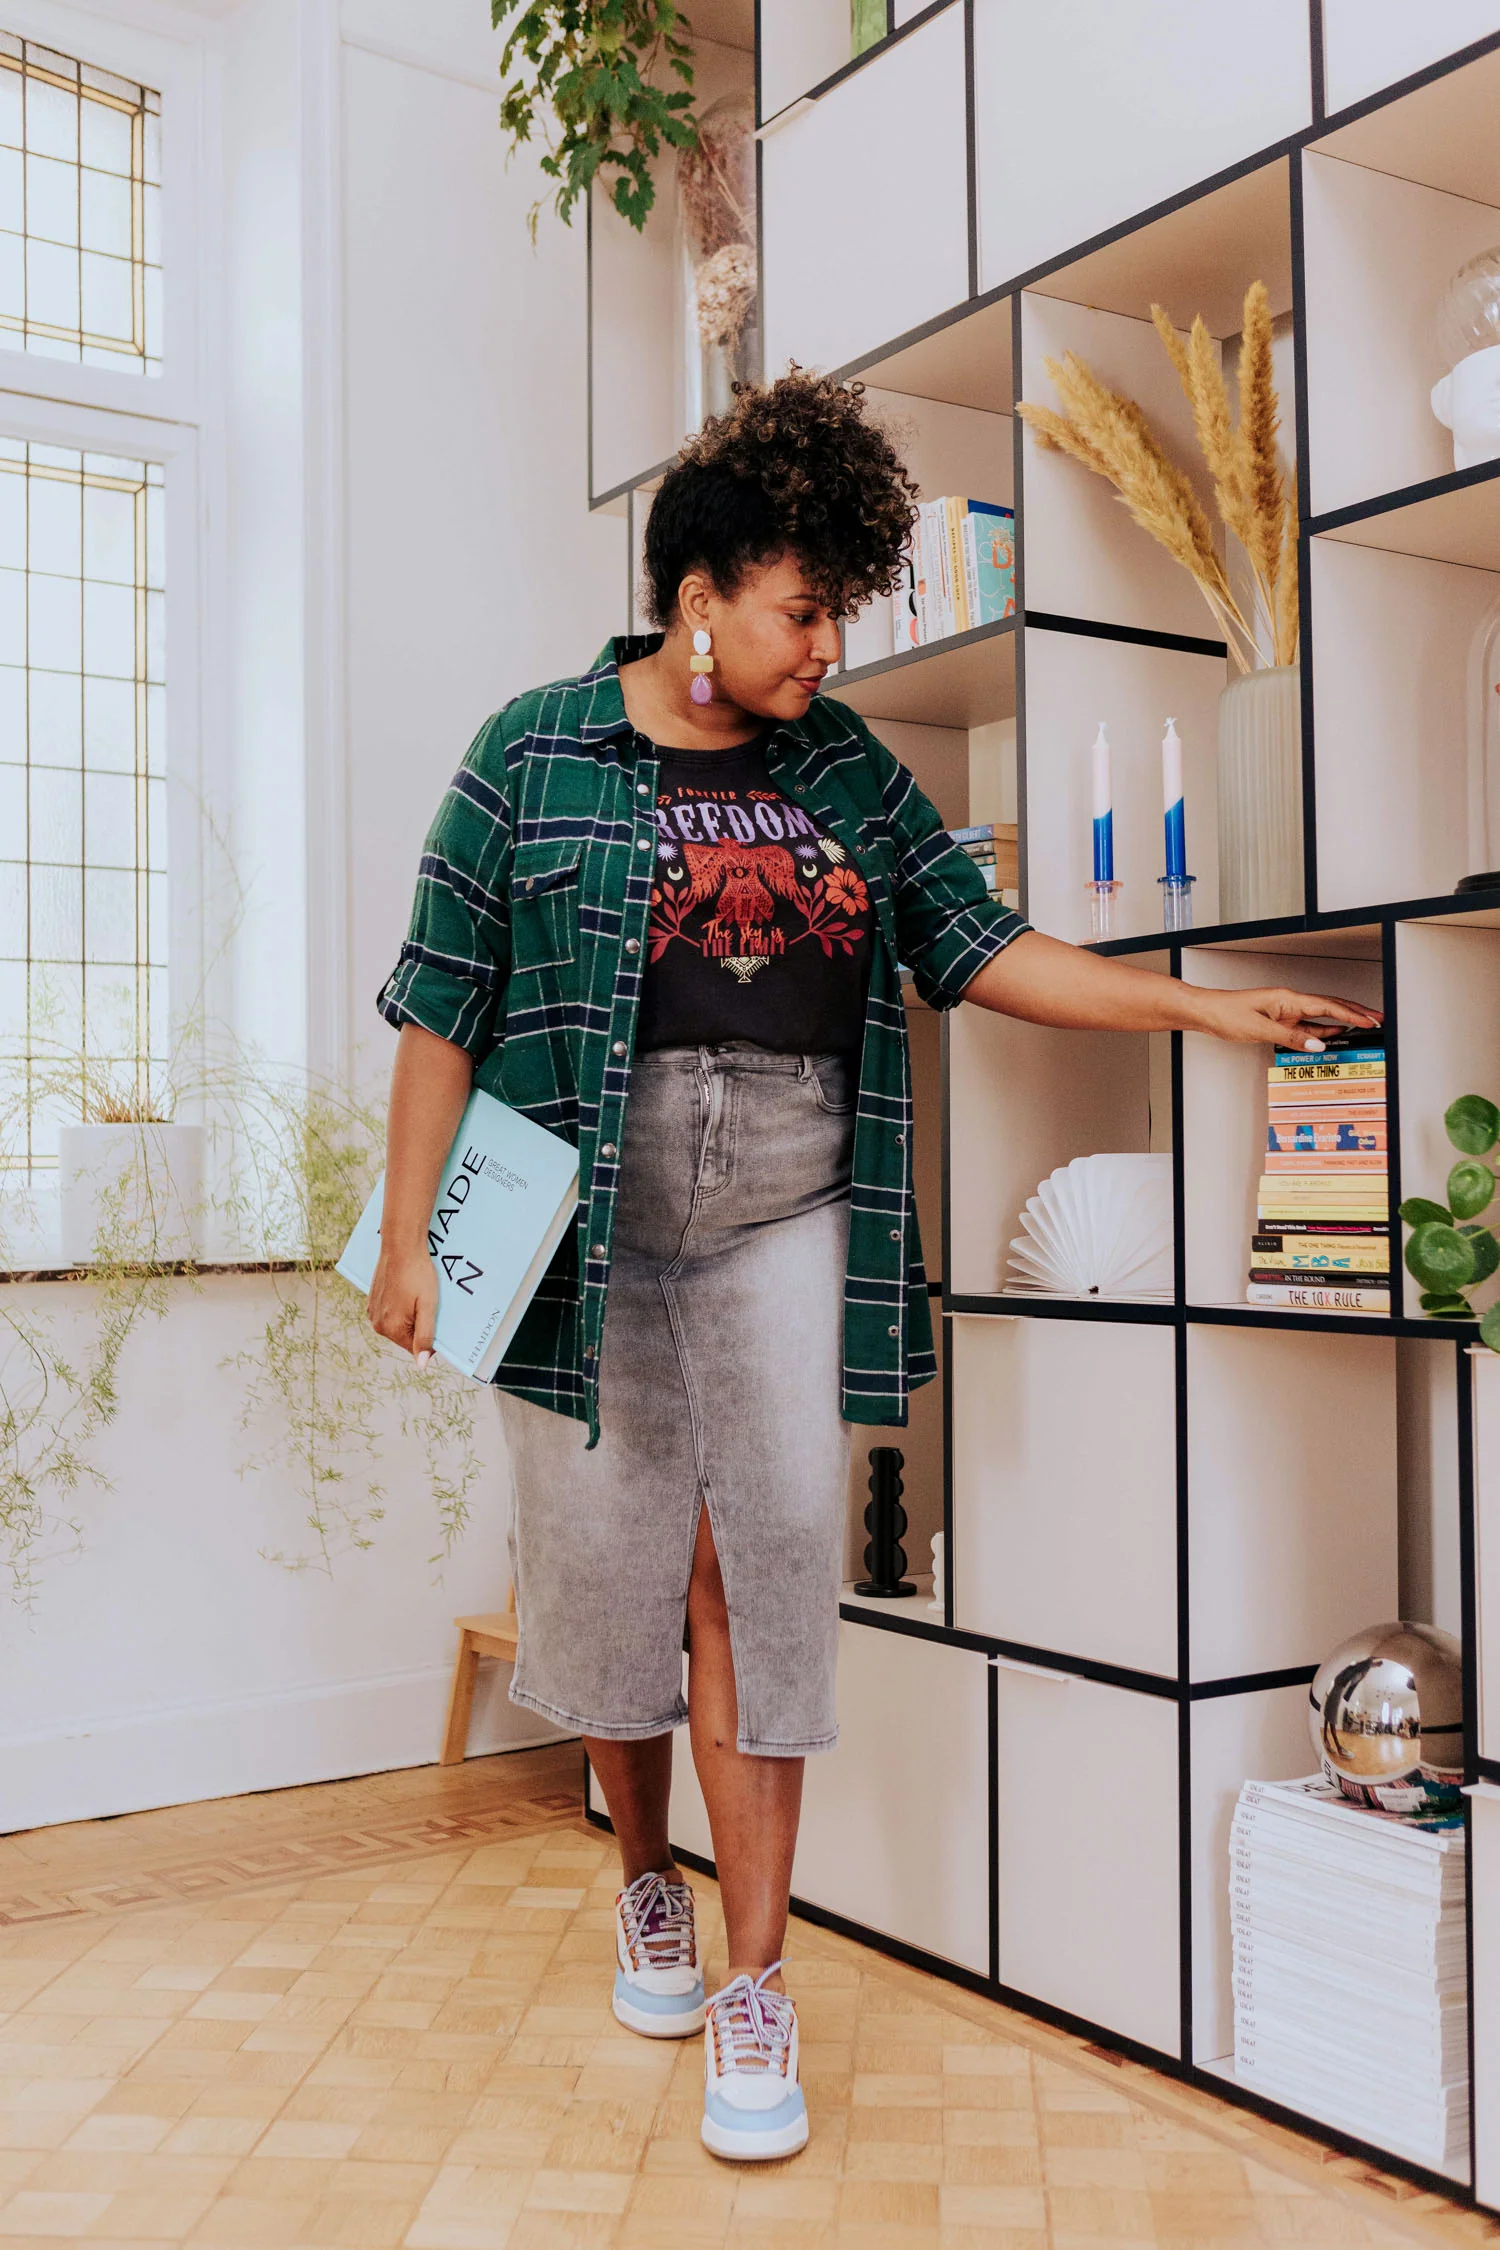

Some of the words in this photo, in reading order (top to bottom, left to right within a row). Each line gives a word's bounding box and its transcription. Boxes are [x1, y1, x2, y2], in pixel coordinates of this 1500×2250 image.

[676, 787, 736, 800] FOREVER
[656, 802, 824, 842] REEDOM
[701, 917, 734, 944] The
[740, 920, 762, 949] sky
[770, 926, 784, 943] is
[700, 938, 734, 958] THE
[740, 937, 786, 956] LIMIT
[1284, 1068, 1296, 1080] THE
[1298, 1066, 1314, 1078] ONE
[1315, 1065, 1340, 1077] THING
[484, 1166, 514, 1192] DESIGNERS
[488, 1159, 507, 1174] GREAT
[506, 1170, 528, 1190] WOMEN
[1288, 1290, 1309, 1305] THE
[1312, 1292, 1332, 1306] 10X
[1335, 1292, 1362, 1308] RULE
[468, 1310, 500, 1363] PHAIDON
